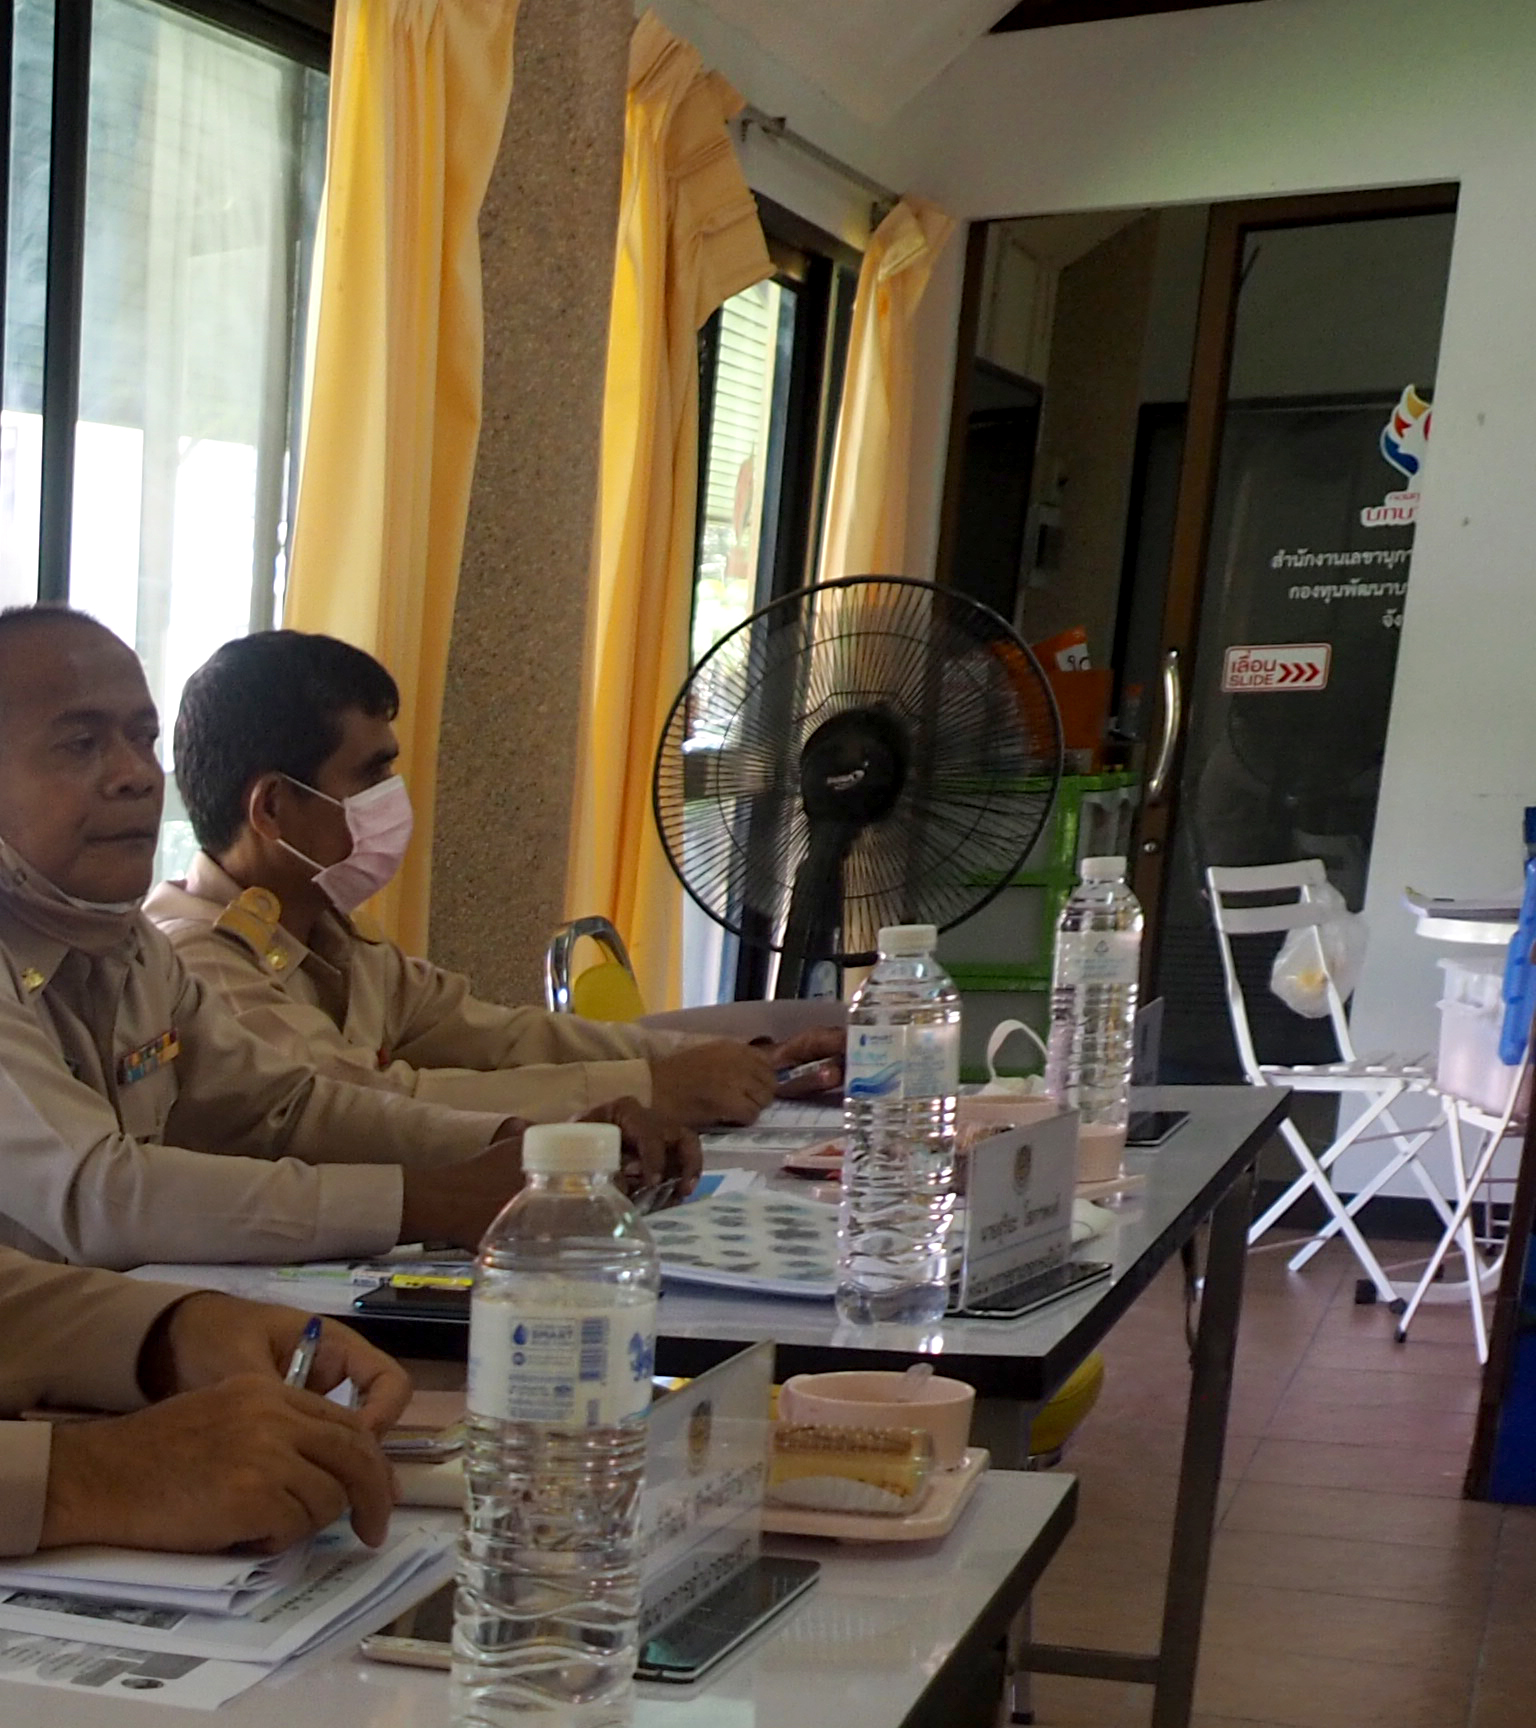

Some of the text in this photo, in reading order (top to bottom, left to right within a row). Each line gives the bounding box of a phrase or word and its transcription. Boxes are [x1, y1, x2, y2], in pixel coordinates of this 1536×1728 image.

[1231, 649, 1277, 673] เลื่อน
[1230, 673, 1274, 687] SLIDE
